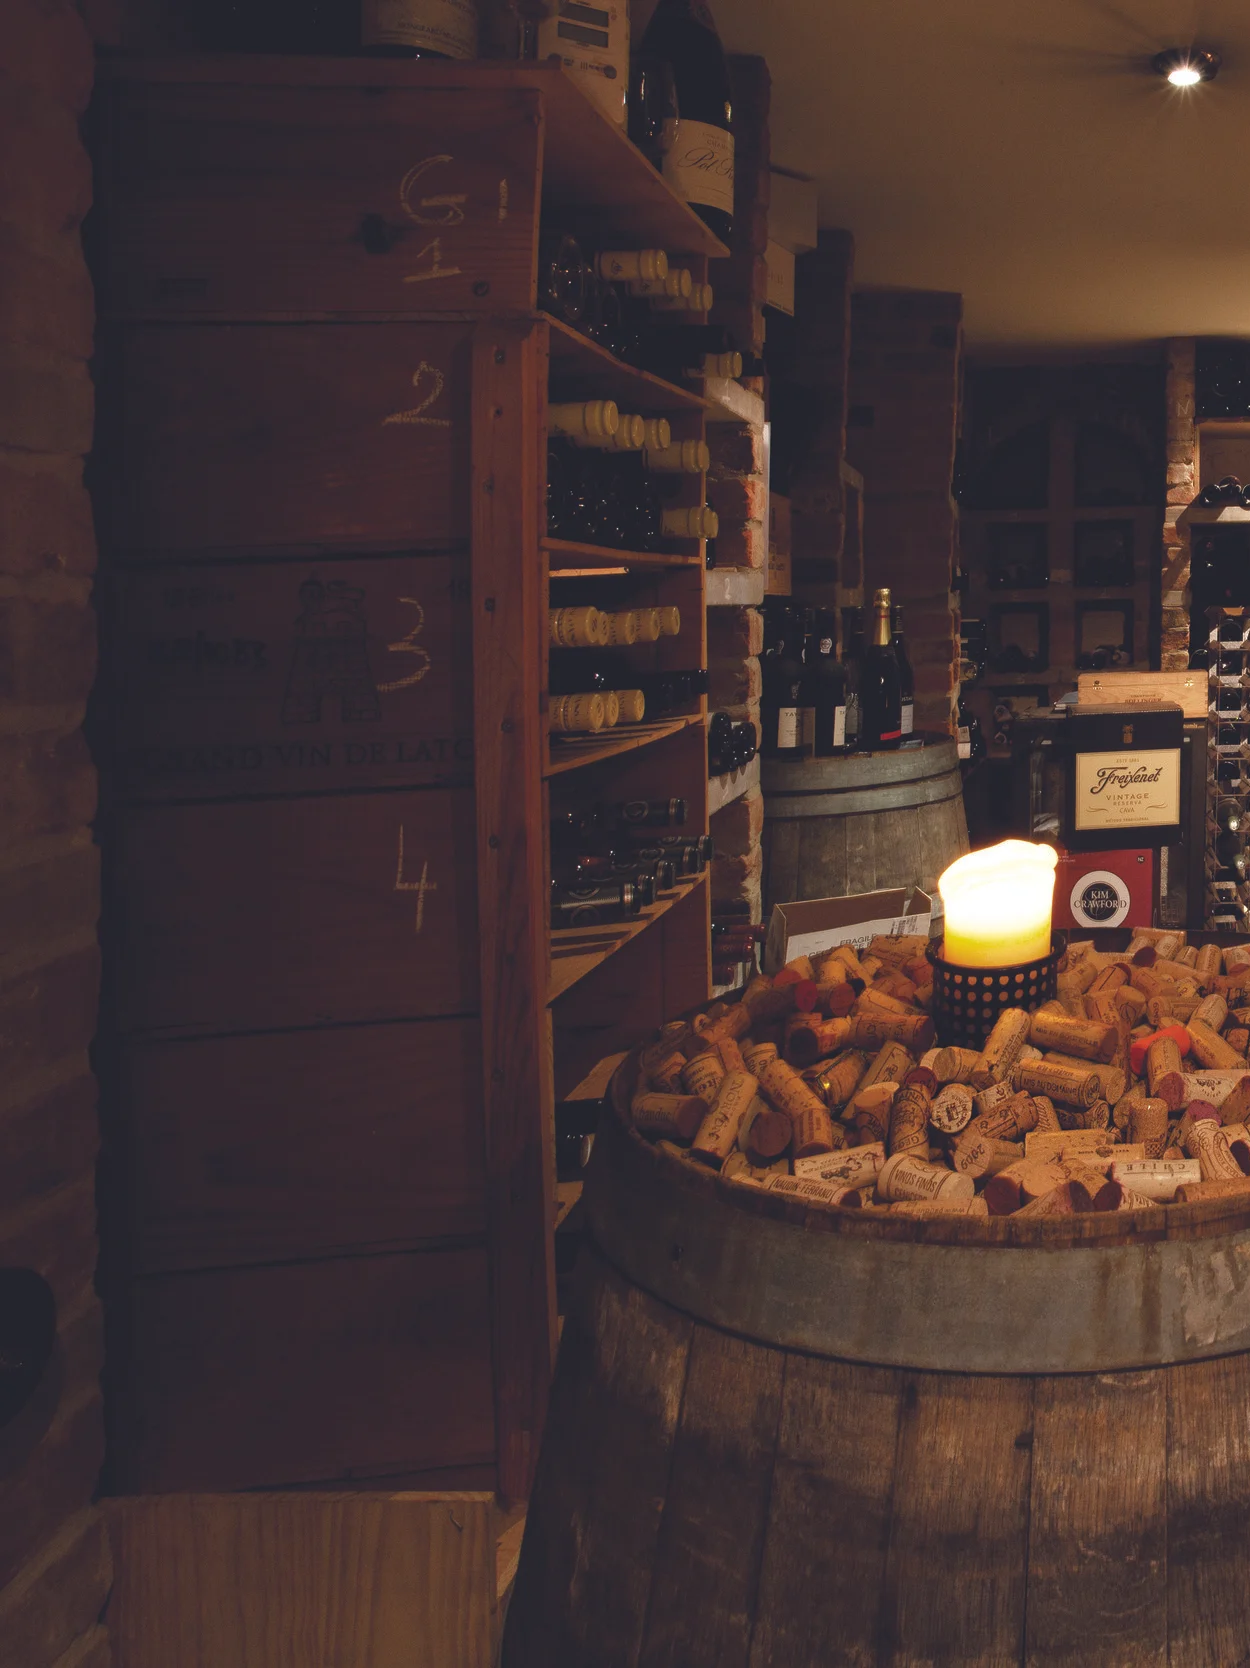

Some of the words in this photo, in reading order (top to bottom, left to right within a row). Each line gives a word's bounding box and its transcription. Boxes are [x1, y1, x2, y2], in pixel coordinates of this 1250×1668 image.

[677, 147, 716, 172] Pol
[381, 360, 453, 428] 2
[375, 595, 432, 694] 3
[271, 742, 334, 769] VIN
[343, 741, 388, 766] DE
[1089, 765, 1164, 796] Freixenet
[1105, 792, 1150, 801] VINTAGE
[1118, 806, 1136, 814] CAVA
[391, 823, 437, 933] 4
[1073, 899, 1127, 909] CRAWFORD
[1091, 890, 1109, 899] KIM
[893, 1168, 917, 1187] VINOS
[916, 1174, 938, 1194] FINOS
